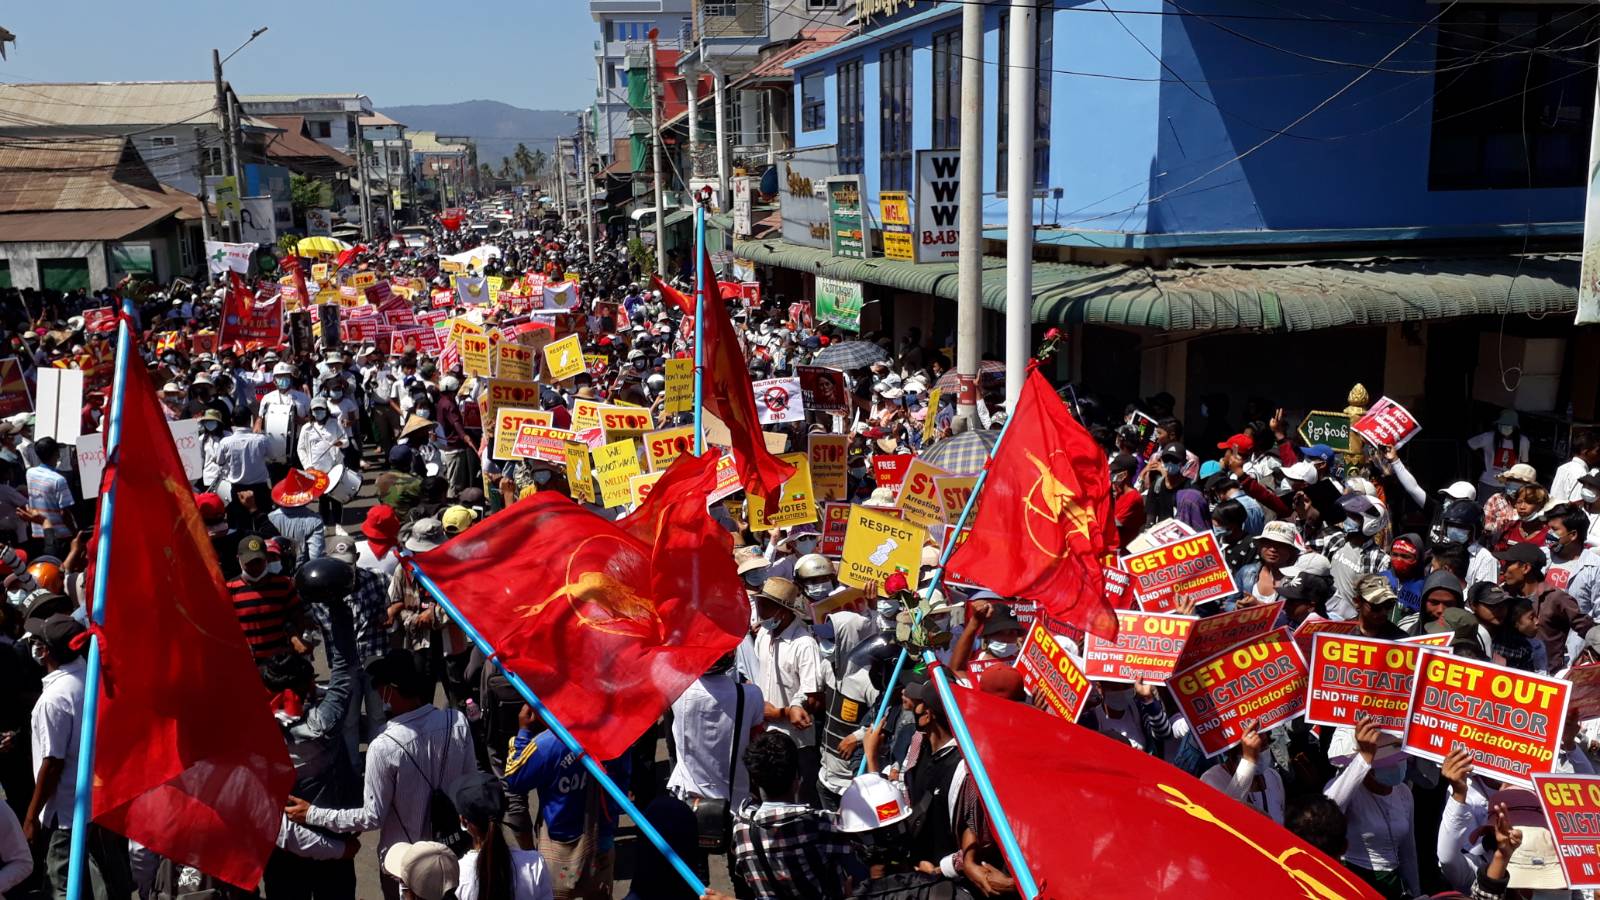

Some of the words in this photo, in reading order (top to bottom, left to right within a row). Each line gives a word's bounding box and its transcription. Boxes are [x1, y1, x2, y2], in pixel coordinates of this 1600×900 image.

[355, 274, 374, 284] STOP
[464, 340, 486, 353] STOP
[501, 347, 531, 360] STOP
[550, 342, 573, 354] RESPECT
[754, 379, 778, 388] MILITARY
[492, 386, 534, 401] STOP
[578, 406, 597, 416] ST
[1394, 410, 1408, 424] CDM
[605, 414, 648, 428] STOP
[523, 427, 547, 436] GET
[549, 431, 574, 440] OUT
[606, 446, 621, 458] WE
[813, 444, 844, 462] STOP
[878, 461, 896, 470] FREE
[910, 472, 936, 499] ST
[906, 494, 940, 513] Arresting
[831, 508, 850, 520] GE
[860, 516, 913, 542] RESPECT
[1130, 550, 1168, 574] GET
[1172, 536, 1210, 561] OUT
[852, 562, 874, 575] OUR
[876, 570, 891, 581] VO
[1139, 554, 1218, 588] DICTATOR
[1105, 582, 1124, 596] every
[1140, 588, 1160, 603] END
[1158, 587, 1172, 596] THE
[1172, 570, 1228, 592] Dictatorship
[1158, 598, 1169, 609] IN
[1119, 616, 1136, 632] ET
[1144, 618, 1190, 635] OUT
[1198, 615, 1234, 634] GET
[1238, 604, 1278, 624] OUT
[1020, 654, 1032, 670] END
[1034, 626, 1060, 658] GET
[1058, 656, 1088, 694] OUT
[1088, 652, 1108, 661] END
[1109, 652, 1124, 661] THE
[1125, 654, 1175, 668] Dictators
[1322, 640, 1378, 666] GET
[1386, 648, 1418, 670] OU
[1104, 664, 1114, 673] IN
[1120, 664, 1172, 680] Myanma
[1178, 660, 1226, 696] GET
[1232, 633, 1284, 670] OUT
[1024, 674, 1032, 686] IN
[1030, 641, 1078, 708] DICTATOR
[1322, 664, 1415, 692] DICTATO
[1193, 656, 1296, 714] DICTATOR
[1426, 659, 1484, 692] GET
[1491, 674, 1558, 710] OUT
[1197, 718, 1220, 735] END
[1220, 709, 1238, 722] THE
[1238, 676, 1310, 716] Dictatorship
[1312, 690, 1340, 702] END
[1341, 692, 1360, 703] THE
[1361, 695, 1408, 712] Dictato
[1332, 706, 1346, 718] IN
[1424, 686, 1549, 736] DICTATOR
[1222, 726, 1235, 740] IN
[1412, 712, 1438, 729] END
[1439, 719, 1458, 732] THE
[1459, 725, 1553, 762] Dictatorship
[1430, 734, 1444, 748] IN
[1544, 782, 1585, 807] GET
[1556, 811, 1600, 834] DICT
[1560, 844, 1582, 857] END
[1582, 845, 1596, 854] THE
[1582, 863, 1594, 876] IN
